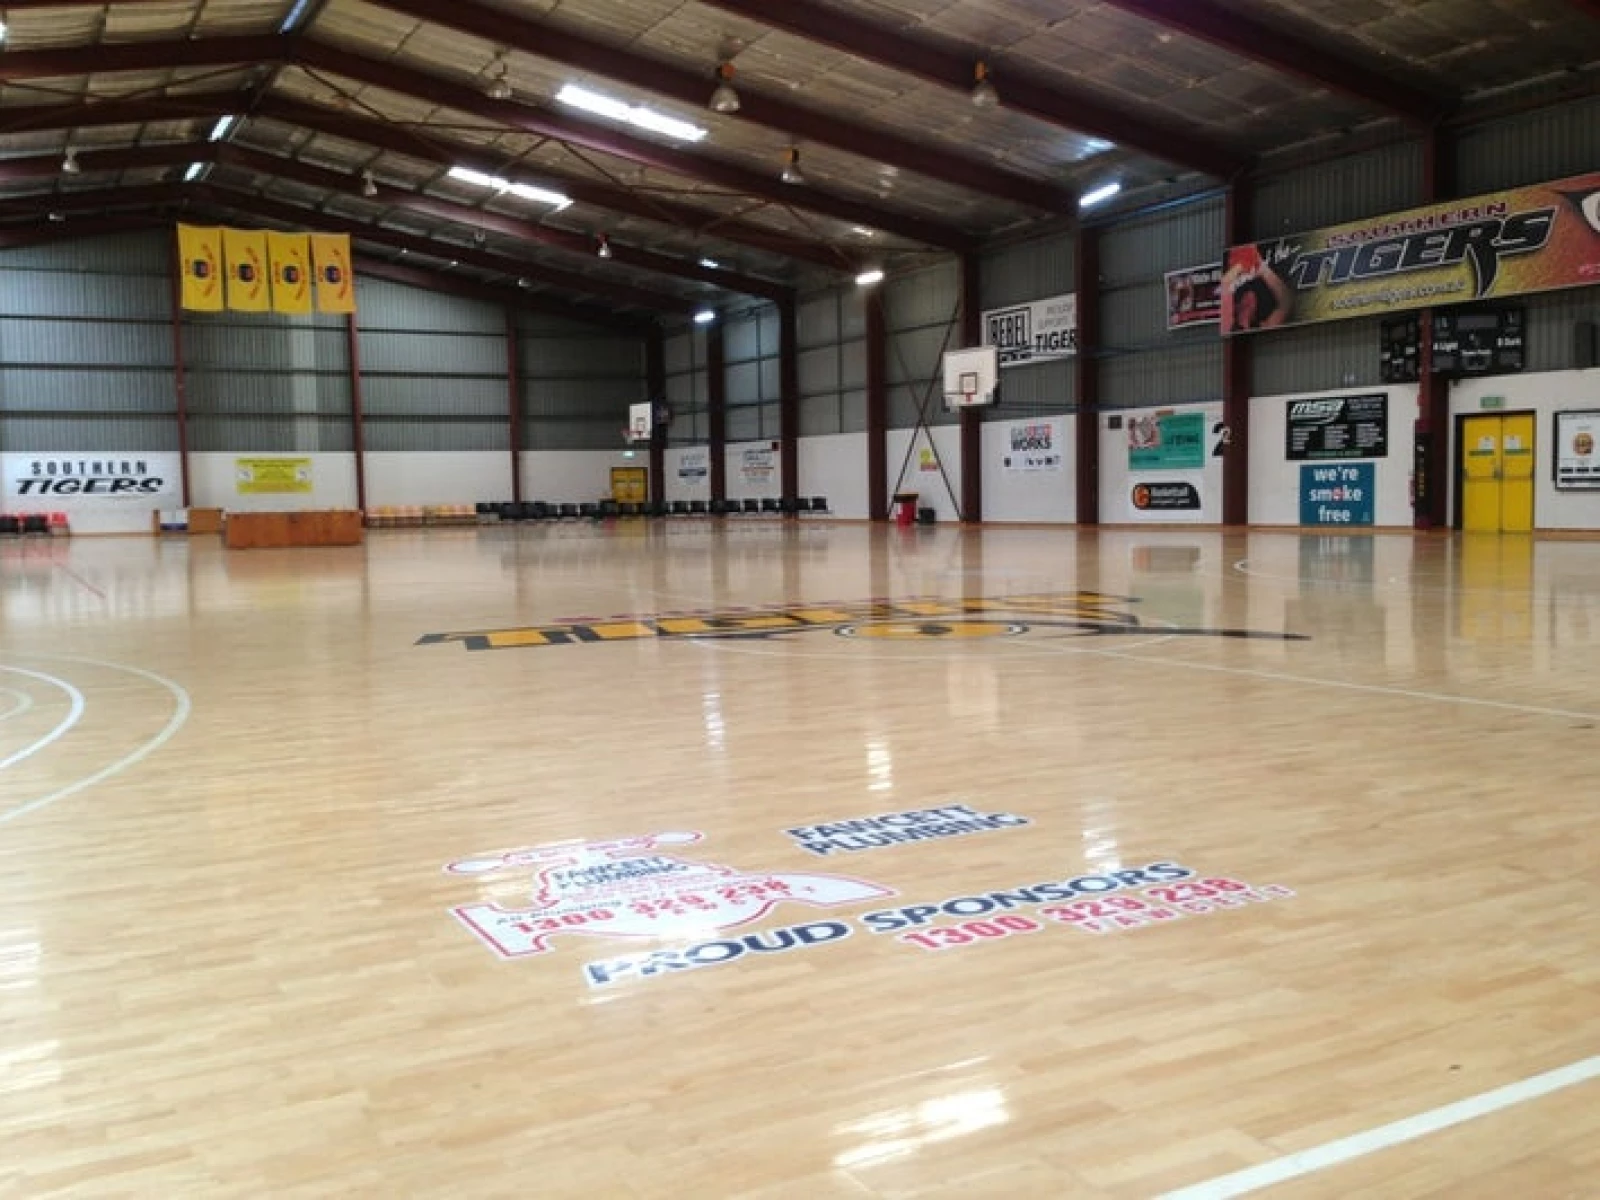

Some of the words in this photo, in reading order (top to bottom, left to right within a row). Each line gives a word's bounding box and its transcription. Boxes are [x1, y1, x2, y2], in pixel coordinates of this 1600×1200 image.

[1327, 202, 1506, 247] SOUTHERN
[1291, 206, 1560, 299] TIGERS
[31, 461, 148, 476] SOUTHERN
[1313, 467, 1359, 482] we're
[16, 478, 164, 495] TIGERS
[1309, 485, 1363, 502] smoke
[1318, 505, 1351, 522] free
[787, 804, 977, 839] FAWCETT
[802, 813, 1029, 855] PLUMBING
[510, 909, 615, 932] 1300
[587, 922, 848, 984] PROUD
[863, 863, 1191, 931] SPONSORS
[902, 915, 1039, 948] 1300
[1042, 898, 1147, 922] 329
[1147, 878, 1246, 902] 238
